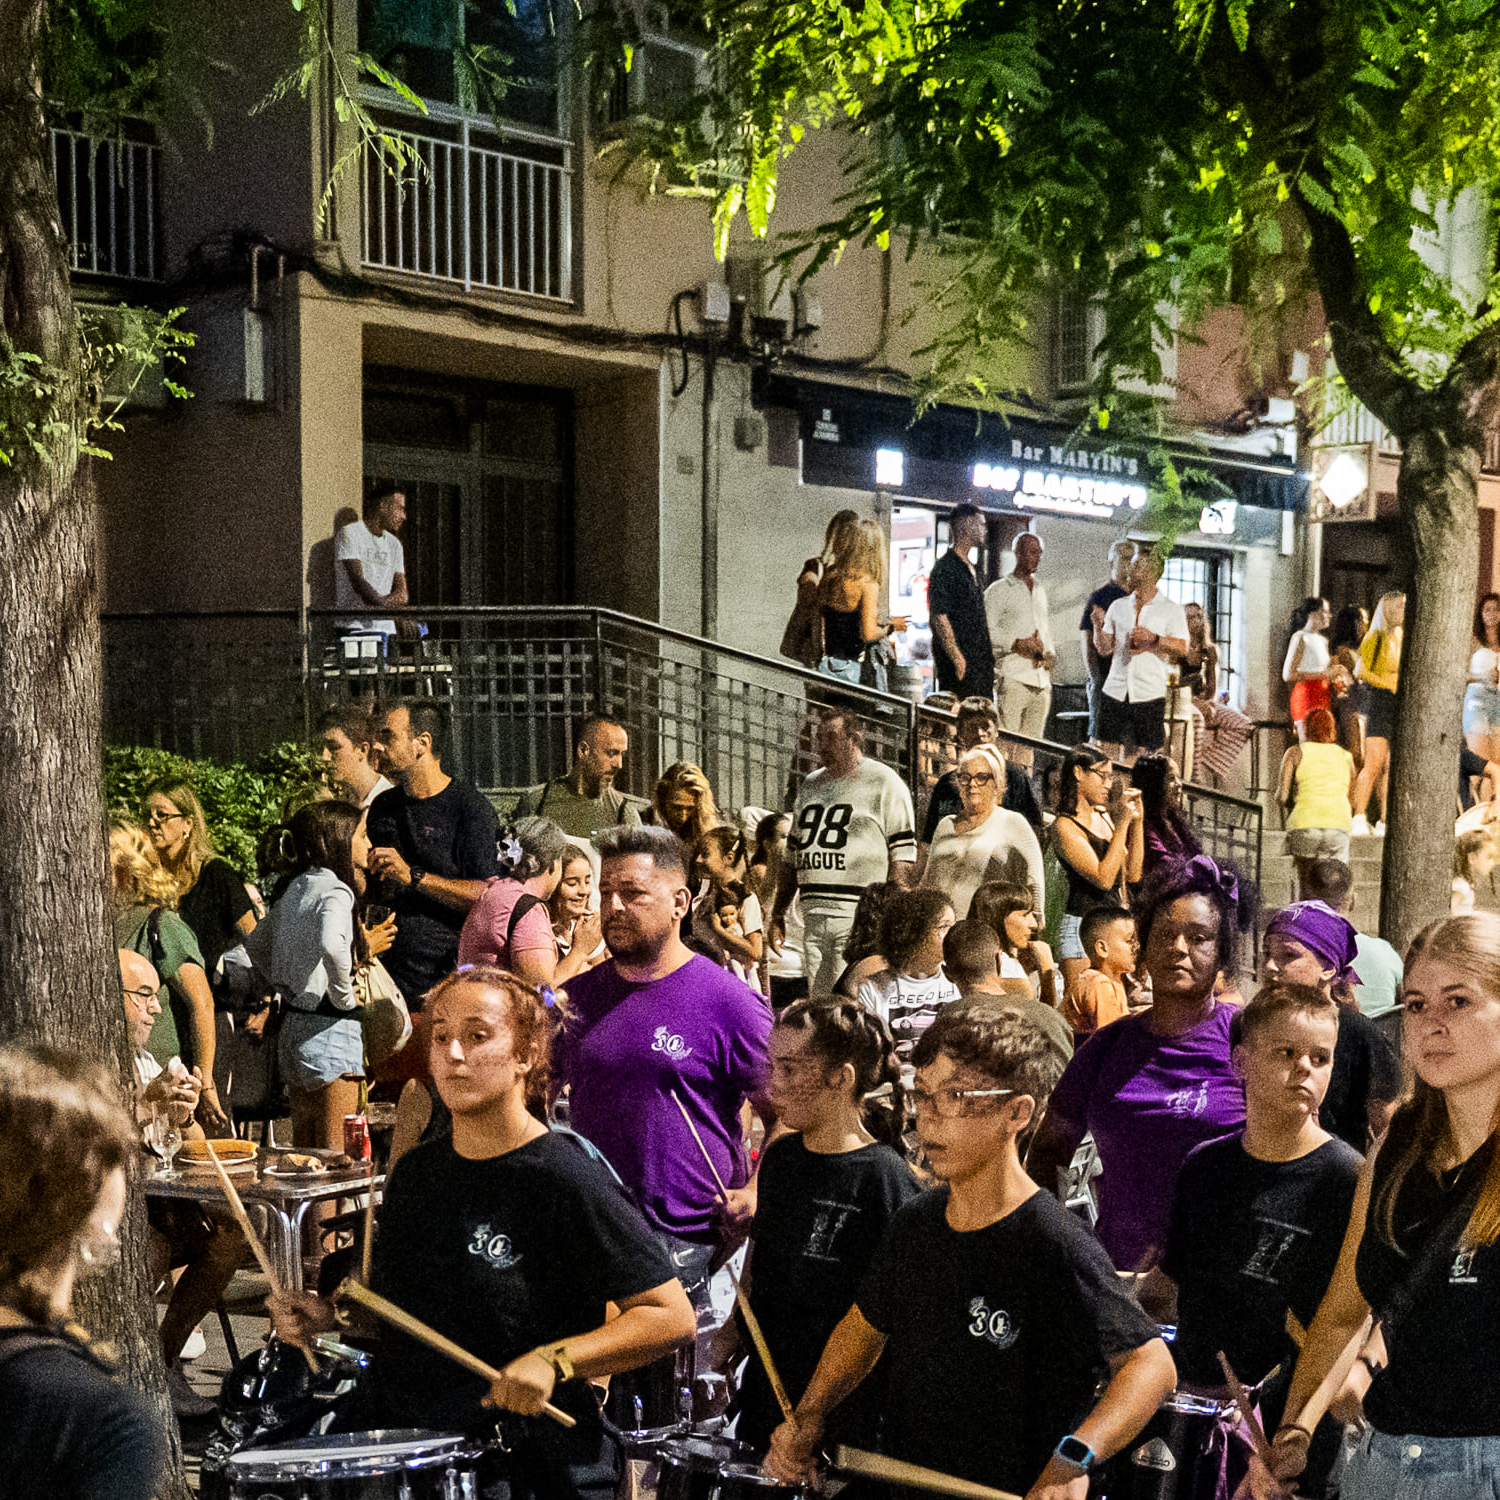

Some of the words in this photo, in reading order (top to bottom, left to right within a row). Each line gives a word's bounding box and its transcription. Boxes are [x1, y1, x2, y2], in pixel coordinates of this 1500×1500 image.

[1011, 439, 1044, 461] Bar
[889, 991, 935, 1005] SPEED
[968, 1305, 1011, 1340] 30
